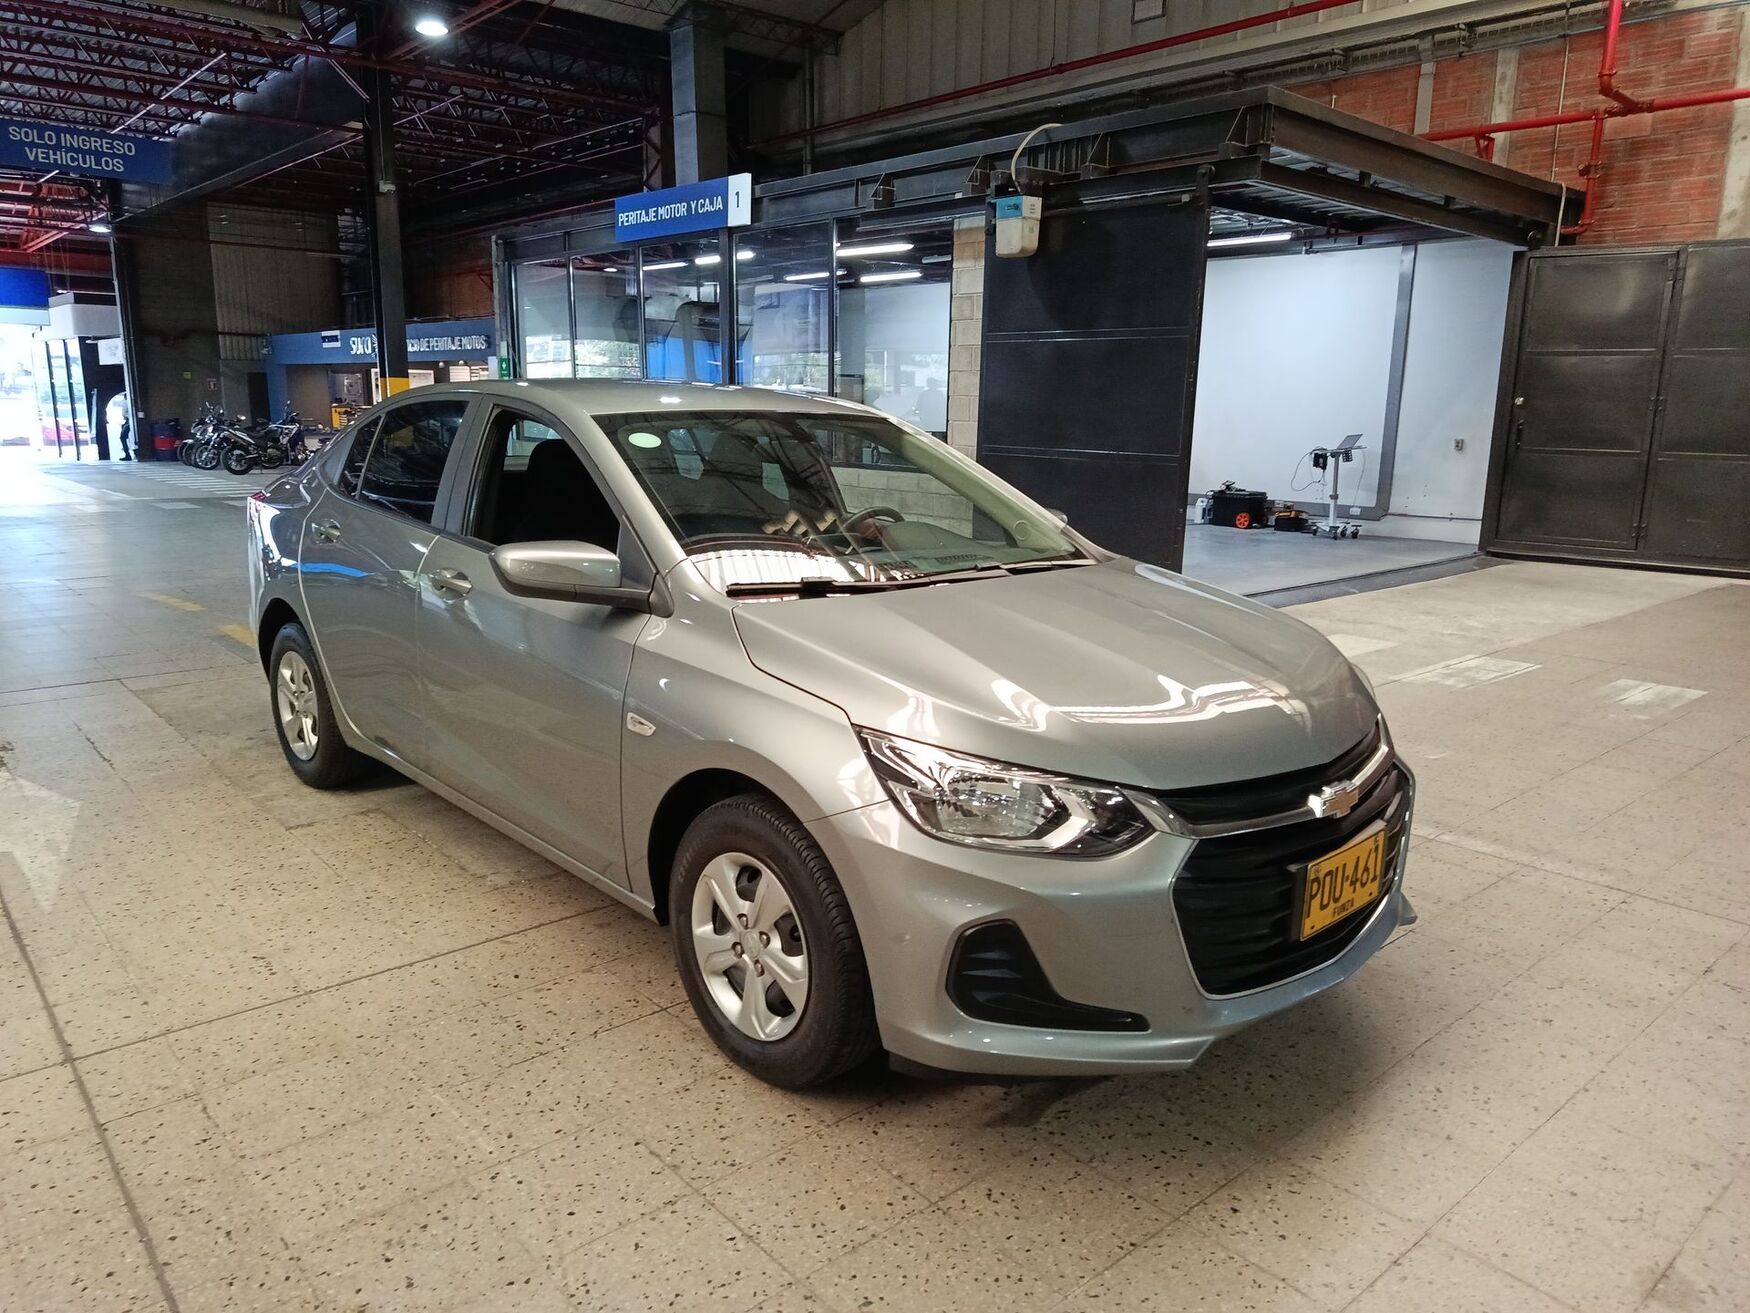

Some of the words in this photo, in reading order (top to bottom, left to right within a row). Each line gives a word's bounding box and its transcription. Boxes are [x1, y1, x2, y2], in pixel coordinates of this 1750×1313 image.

[9, 126, 56, 145] SOLO
[61, 132, 136, 156] INGRESO
[25, 147, 124, 172] VEHÍCULOS
[618, 207, 657, 227] PERITAJE
[658, 202, 687, 219] MOTOR
[690, 200, 697, 215] Y
[699, 195, 723, 213] CAJA
[735, 191, 740, 208] 1
[420, 338, 430, 351] DE
[430, 336, 461, 351] PERITAJE
[461, 335, 488, 350] MOTOS
